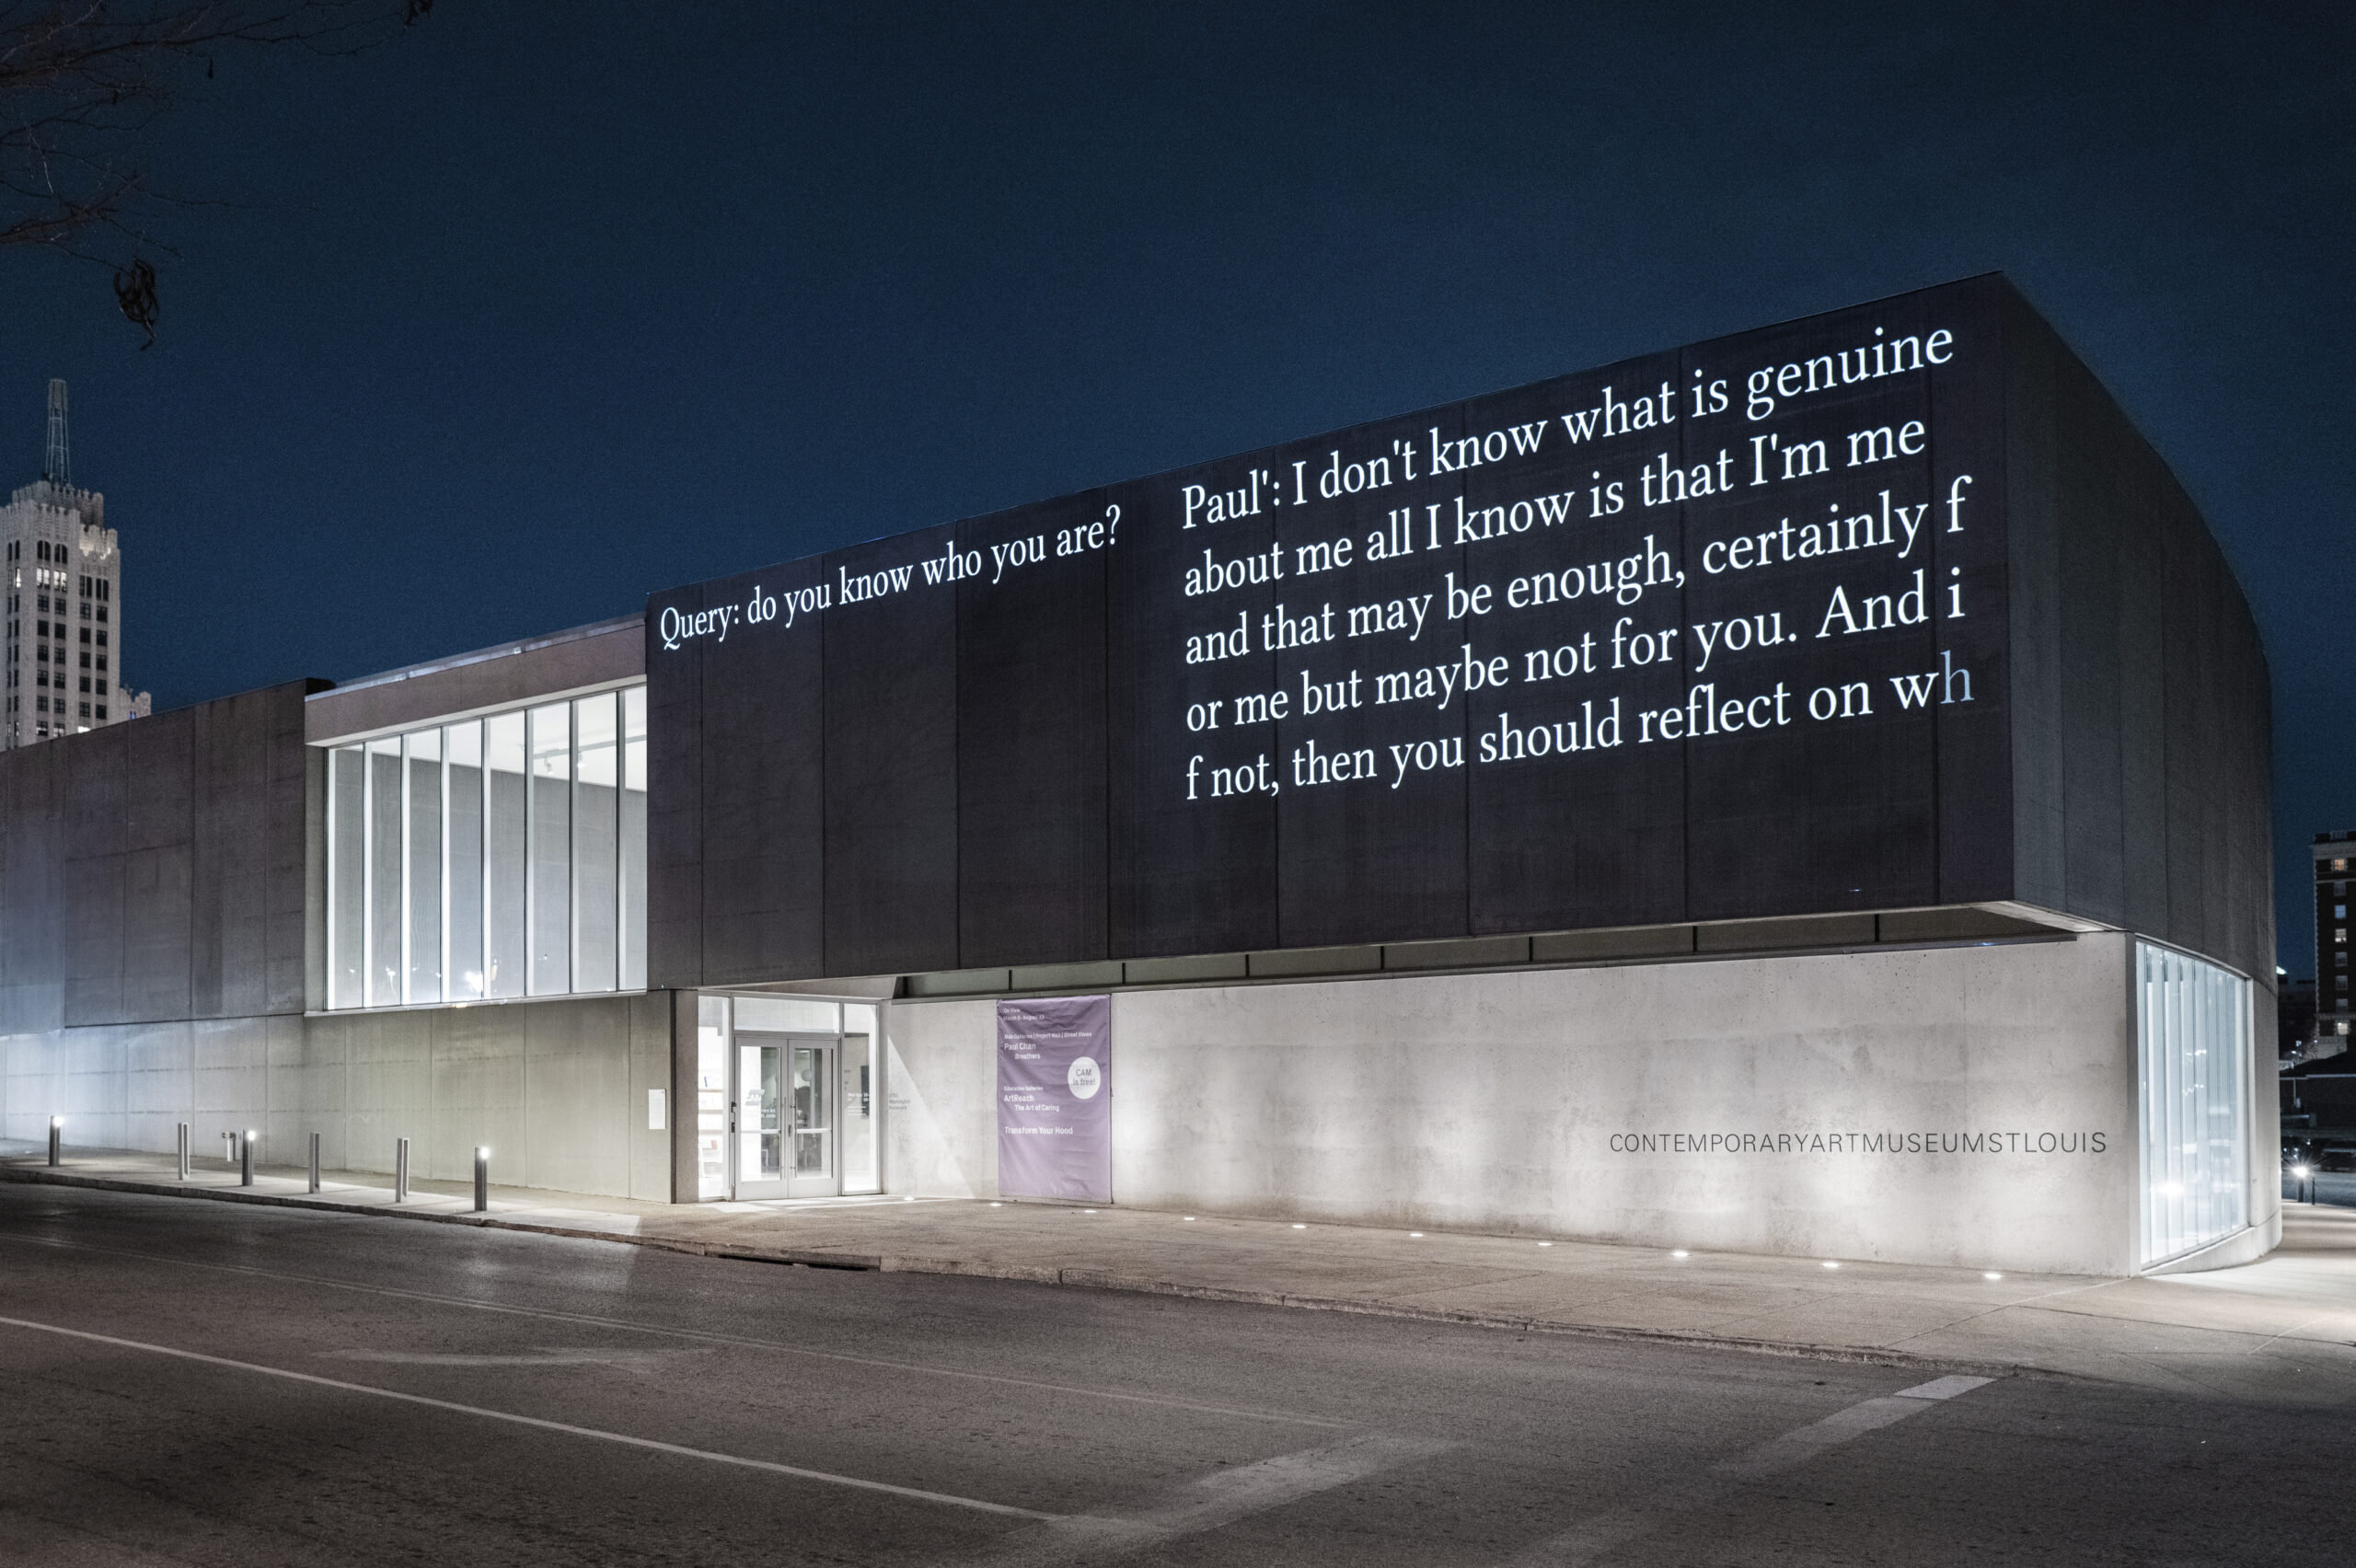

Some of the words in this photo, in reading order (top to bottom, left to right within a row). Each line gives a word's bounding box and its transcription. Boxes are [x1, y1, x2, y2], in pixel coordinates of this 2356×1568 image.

[1182, 469, 1279, 529] Paul':
[1292, 461, 1307, 505] I
[1321, 440, 1416, 498] don't
[1429, 421, 1548, 475] know
[1561, 382, 1675, 444] what
[1692, 369, 1728, 417] is
[1747, 327, 1953, 421] genuine
[661, 605, 738, 650] Query:
[748, 585, 776, 624] do
[784, 584, 831, 628] you
[839, 565, 913, 605] know
[921, 540, 981, 585] who
[990, 536, 1046, 584] you
[1057, 504, 1120, 556] are?
[1185, 542, 1284, 596] about
[1296, 538, 1352, 575] me
[1367, 507, 1414, 560] all
[1426, 504, 1441, 549] I
[1454, 491, 1575, 544] know
[1589, 471, 1623, 517] is
[1641, 449, 1734, 506] that
[1750, 433, 1830, 486] I'm
[1847, 421, 1924, 467] me
[1186, 611, 1250, 663] and
[1262, 603, 1334, 651] that
[1348, 594, 1433, 641] may
[1445, 572, 1492, 619] be
[1507, 535, 1685, 608] enough,
[1703, 490, 1928, 573] certainly
[1946, 475, 1972, 533] f
[1186, 755, 1203, 800] f
[1211, 754, 1278, 797] not,
[1292, 739, 1377, 786] then
[1389, 737, 1465, 789] you
[1480, 697, 1623, 762] should
[1639, 682, 1791, 743] reflect
[1809, 683, 1873, 720] on
[1889, 651, 1974, 709] wh
[1187, 701, 1222, 732] or
[1234, 691, 1288, 725] me
[1300, 670, 1362, 715] but
[1375, 643, 1508, 709] maybe
[1524, 632, 1596, 682] not
[1611, 617, 1678, 669] for
[1692, 612, 1796, 673] you.
[1816, 569, 1929, 638] And
[1948, 567, 1965, 618] i
[1004, 1094, 1034, 1102] ArtReach
[1080, 1078, 1096, 1086] free!
